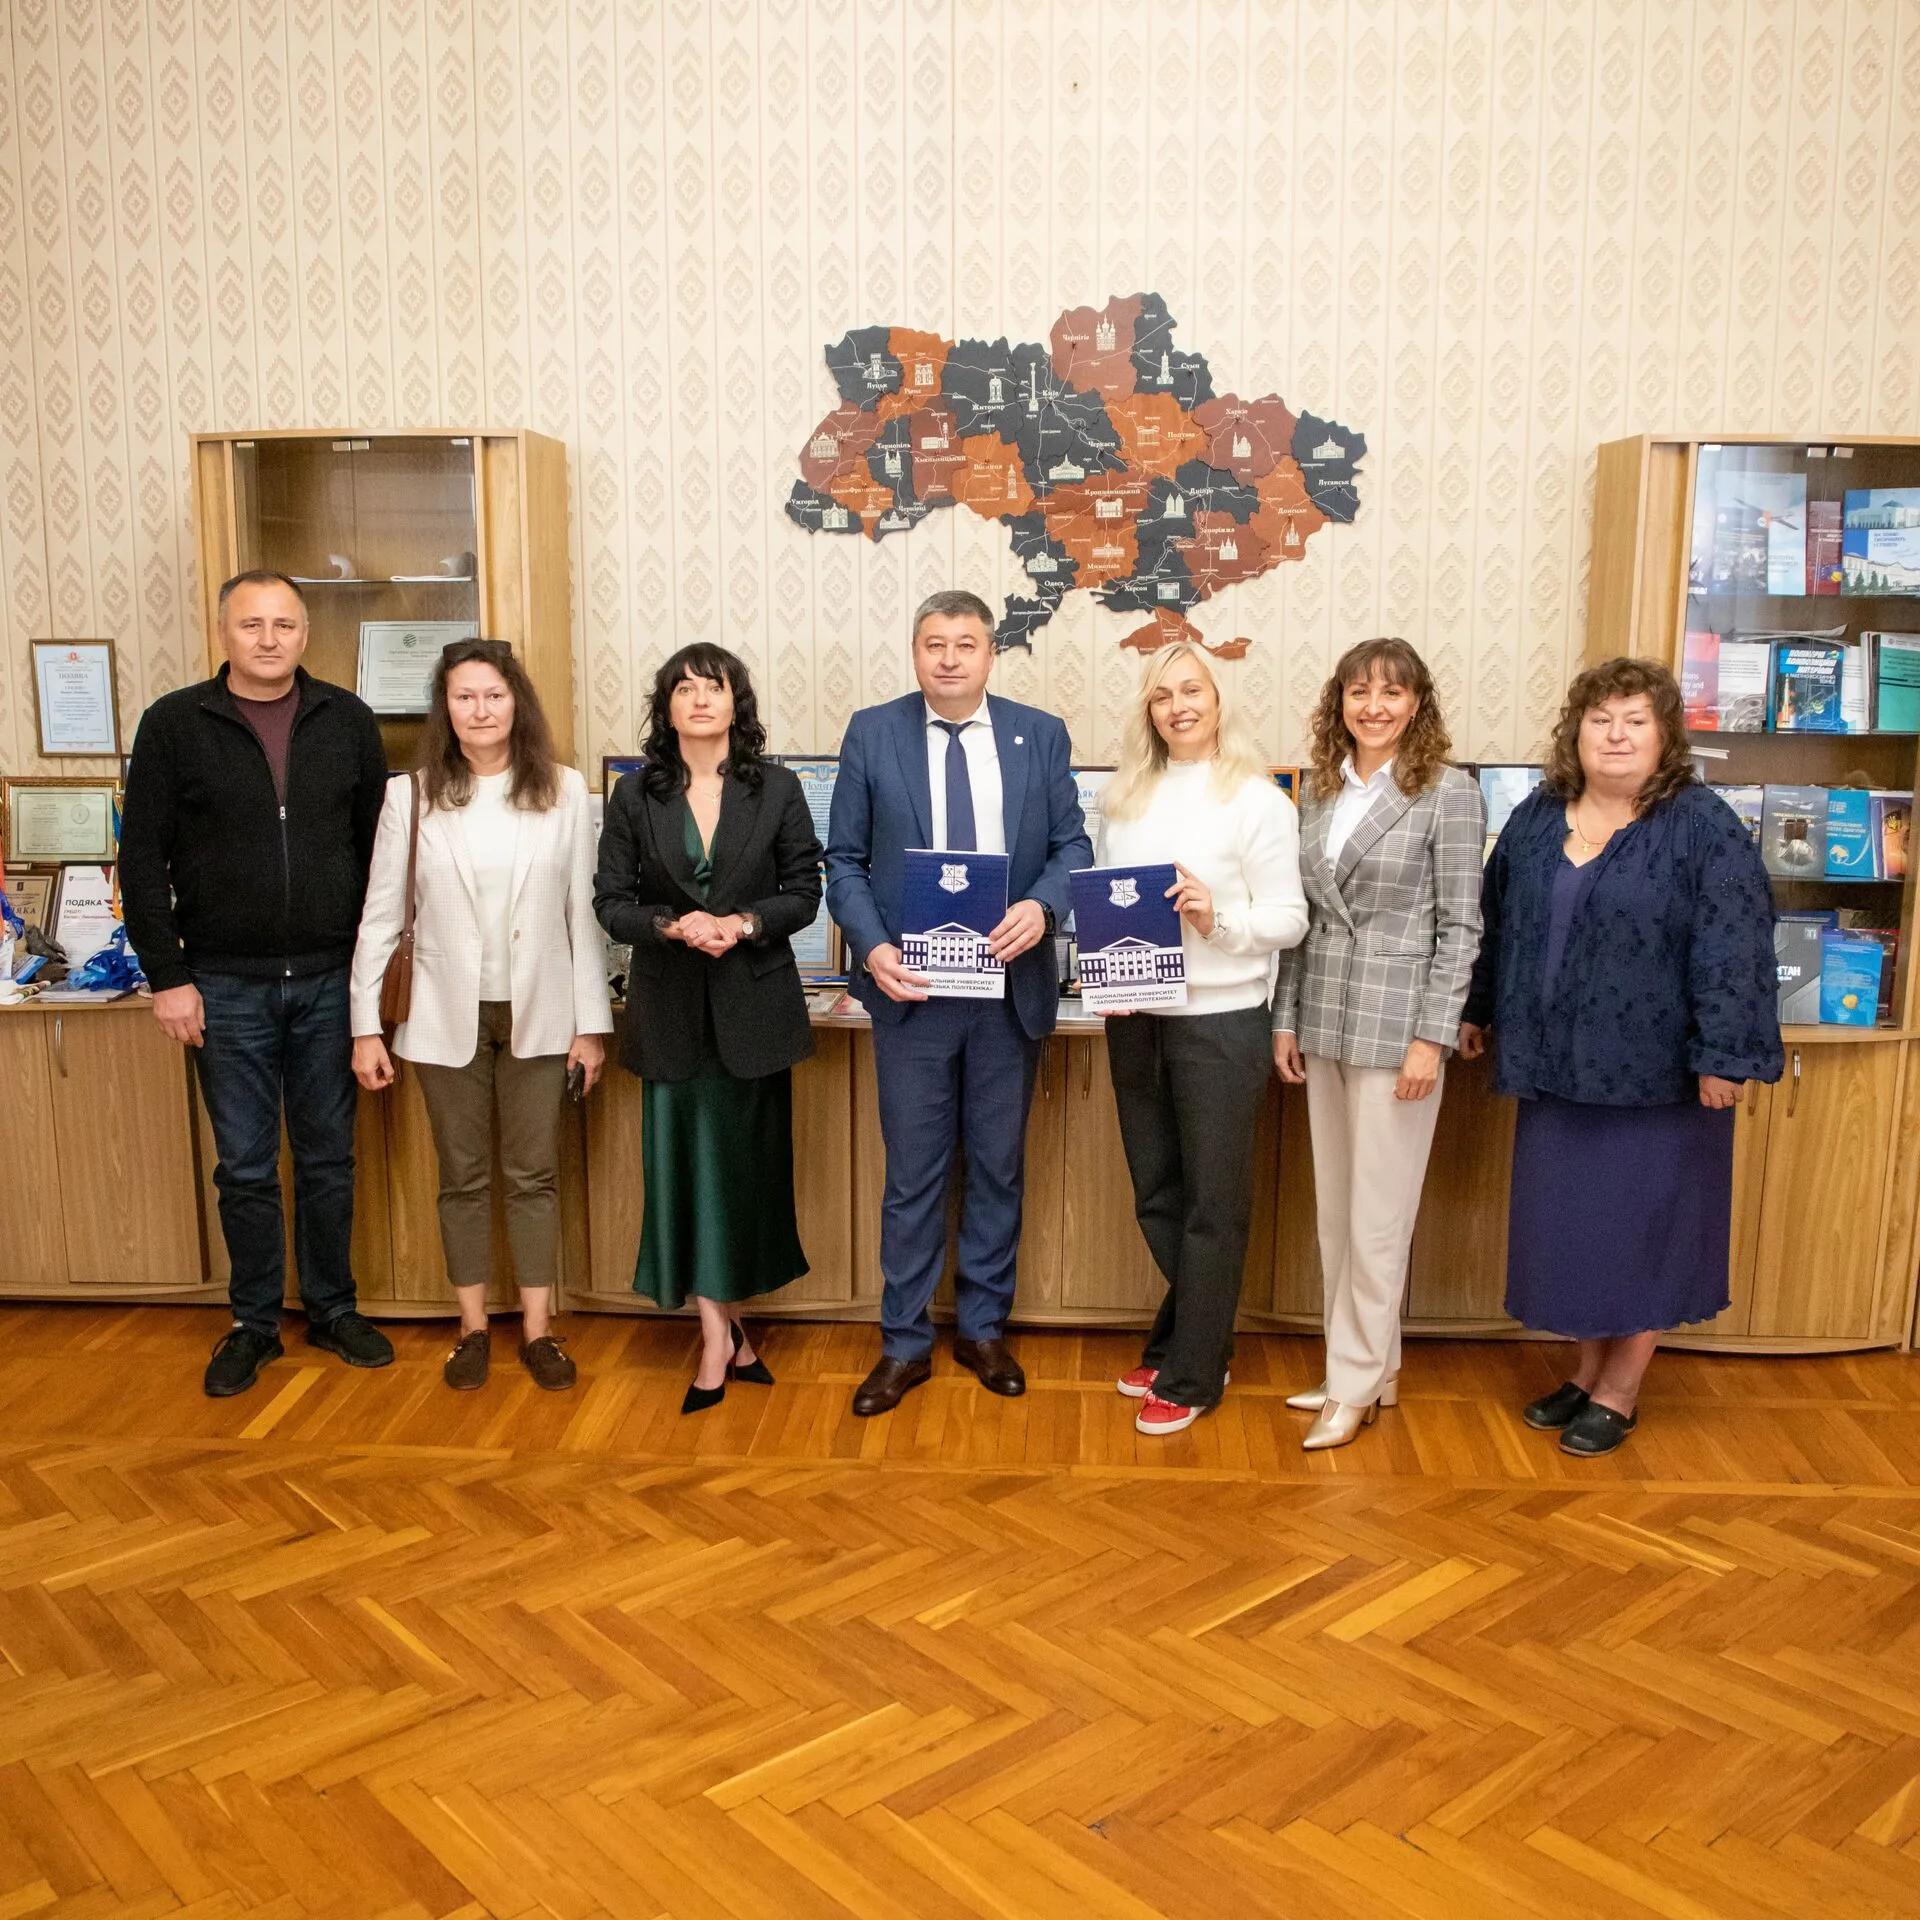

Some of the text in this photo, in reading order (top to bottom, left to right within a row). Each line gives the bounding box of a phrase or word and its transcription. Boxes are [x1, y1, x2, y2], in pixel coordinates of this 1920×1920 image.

[65, 899, 102, 907] ПОДЯКА
[1089, 989, 1178, 1000] НАЦІОНАЛЬНИЙ УНІВЕРСИТЕТ
